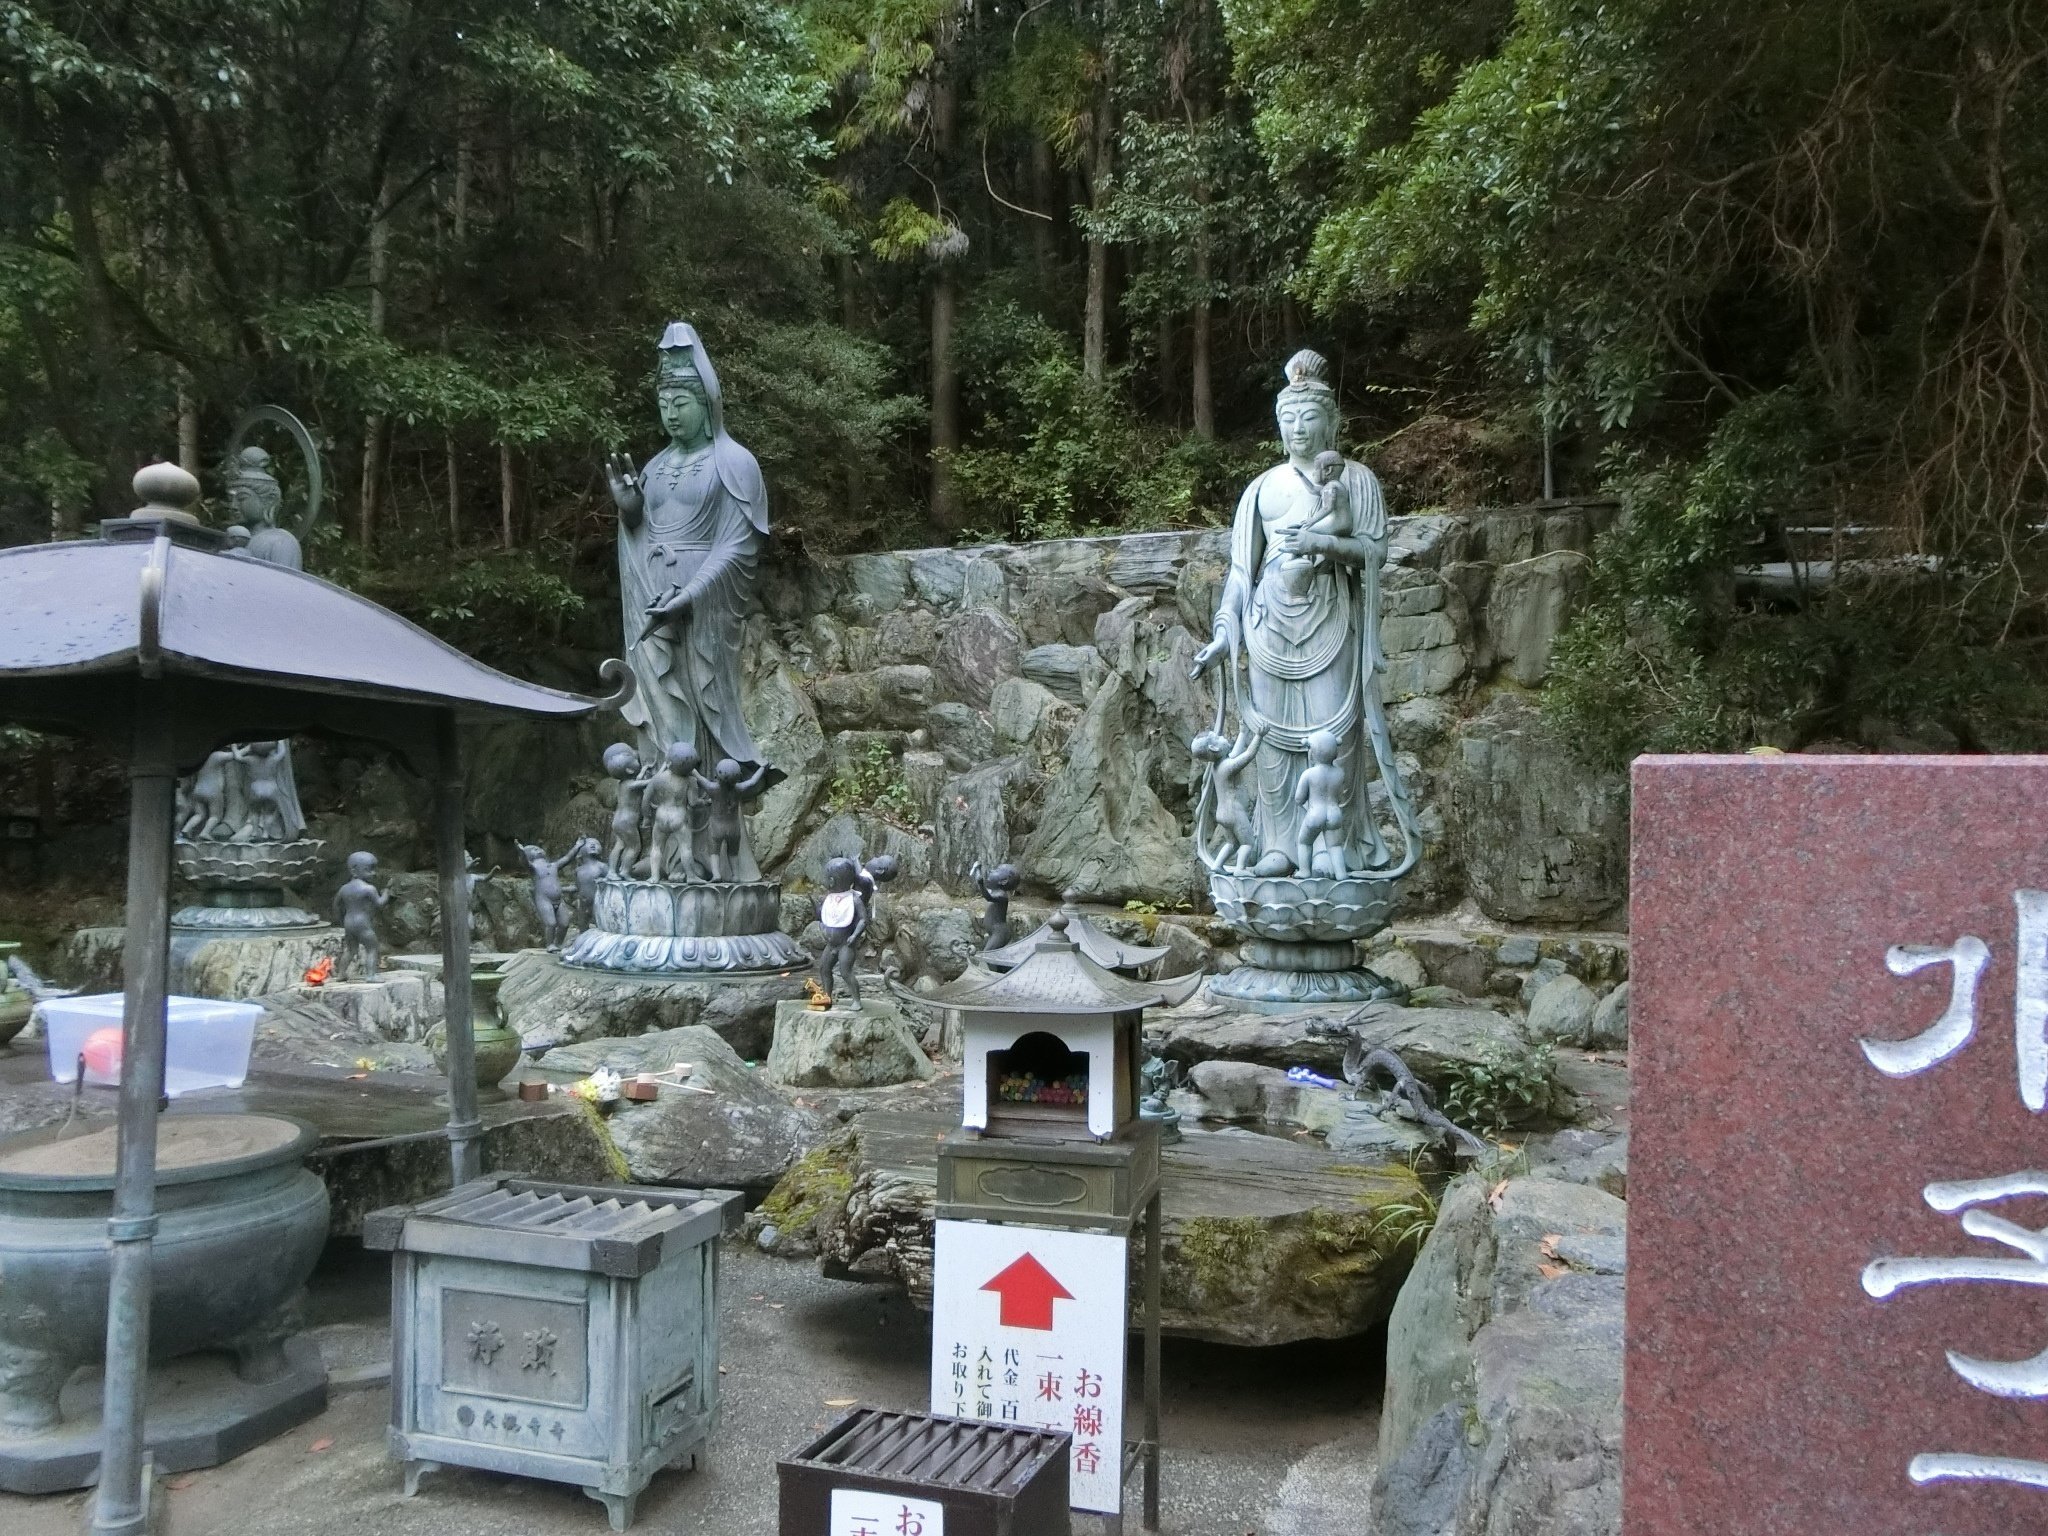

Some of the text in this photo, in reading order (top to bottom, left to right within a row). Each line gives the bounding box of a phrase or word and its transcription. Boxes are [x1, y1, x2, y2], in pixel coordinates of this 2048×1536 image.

[952, 1342, 967, 1417] お取り下
[977, 1346, 993, 1419] 入れて御
[1035, 1354, 1063, 1429] 一束
[1073, 1368, 1102, 1475] お線香
[850, 1517, 879, 1536] 一
